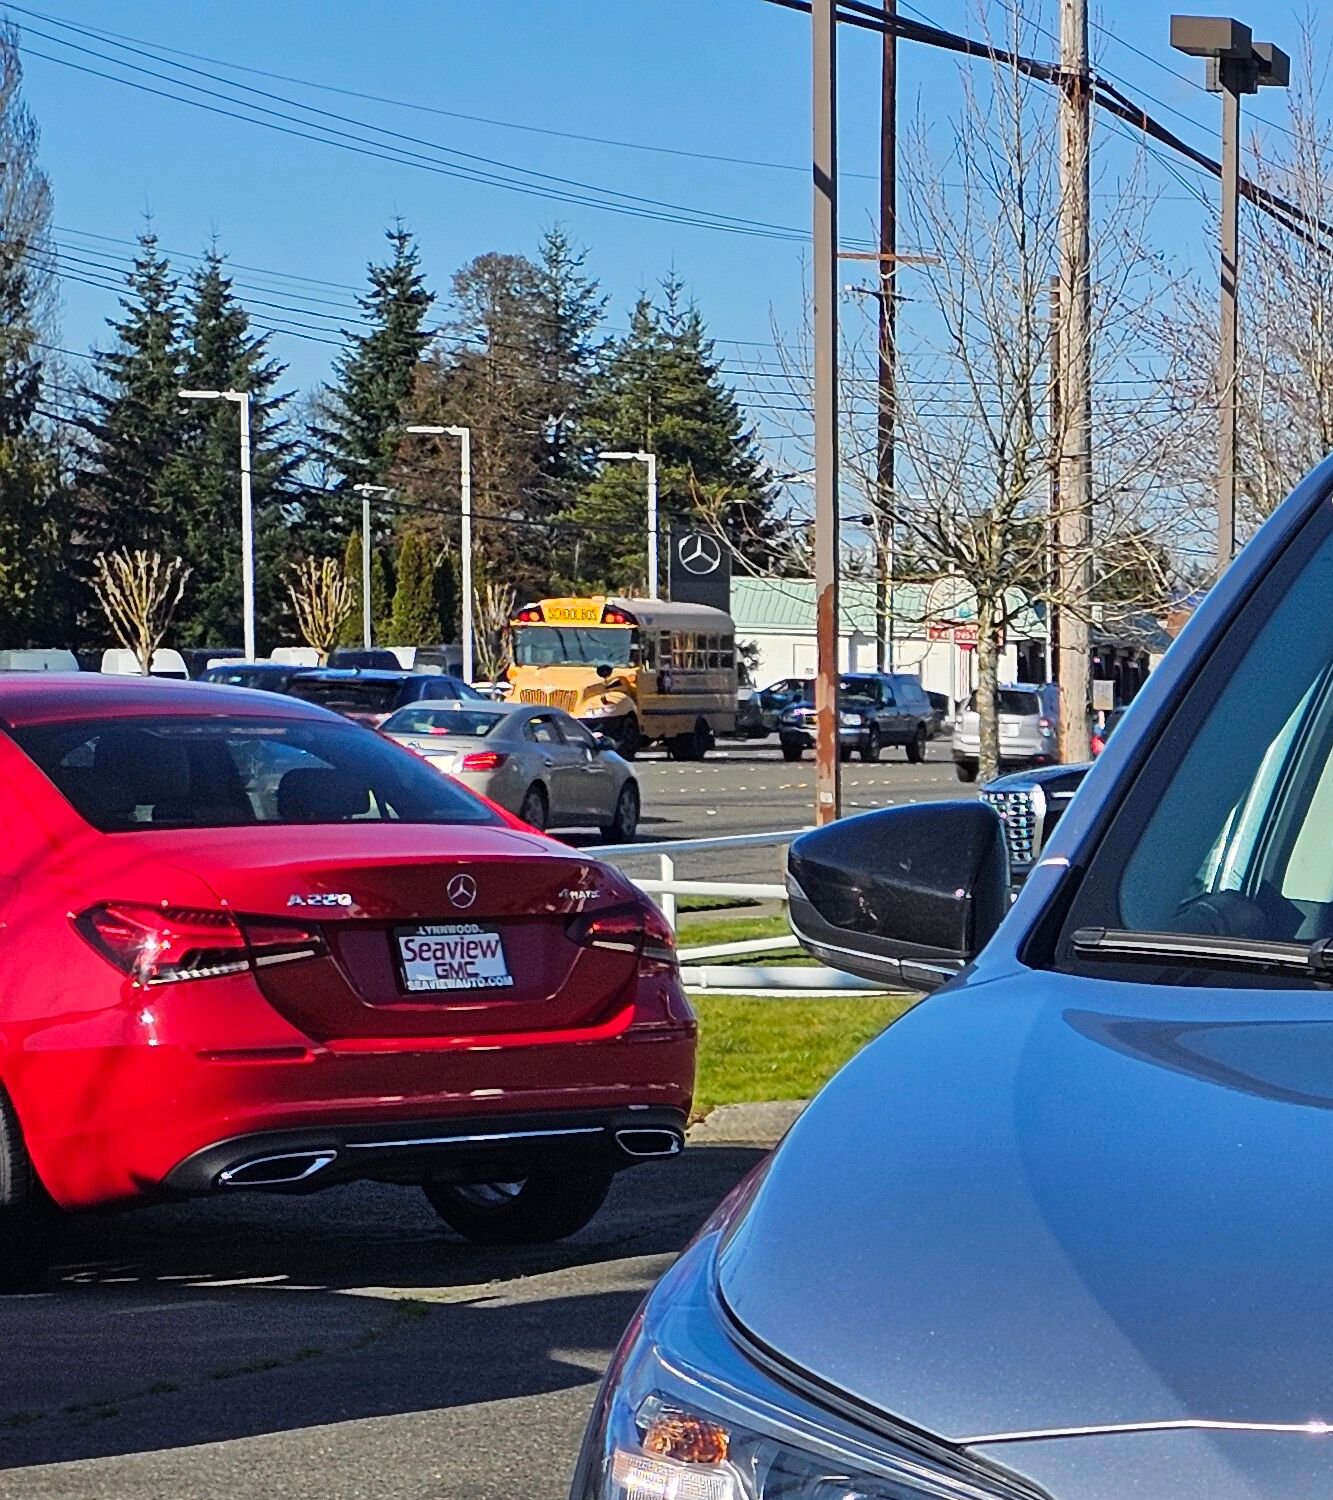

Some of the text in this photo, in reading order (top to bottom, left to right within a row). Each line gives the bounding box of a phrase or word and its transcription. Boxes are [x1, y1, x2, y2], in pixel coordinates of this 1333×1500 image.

[418, 924, 481, 936] LYNNWOOD
[404, 937, 501, 963] Seaview
[434, 961, 480, 979] GMC
